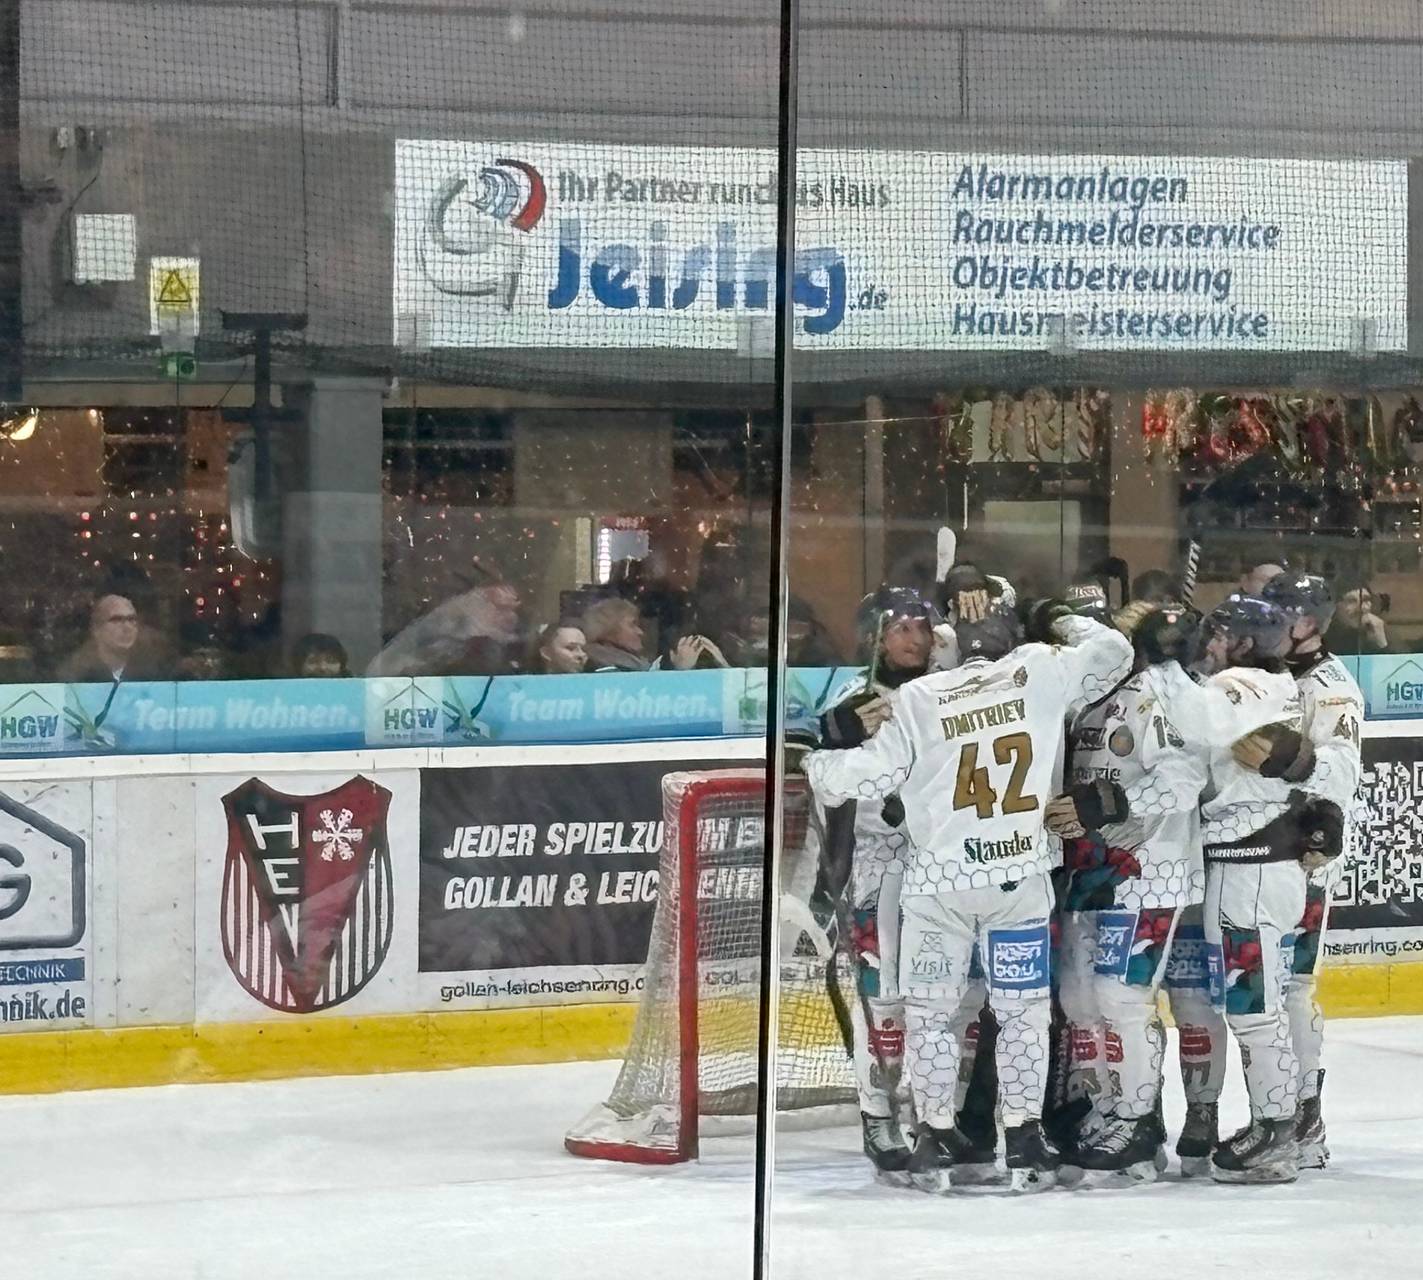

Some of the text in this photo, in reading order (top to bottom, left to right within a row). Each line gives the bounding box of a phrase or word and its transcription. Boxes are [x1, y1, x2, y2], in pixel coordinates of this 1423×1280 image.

[559, 168, 598, 202] Ihr
[606, 171, 701, 203] Partner
[951, 165, 1189, 210] Alarmanlagen
[952, 209, 1280, 248] Rauchmelderservice
[952, 256, 1233, 301] Objektbetreuung
[134, 698, 217, 731] Team
[384, 705, 440, 730] HGW
[509, 691, 584, 722] Team
[1, 715, 59, 739] HGW
[952, 731, 1039, 820] 42
[443, 824, 536, 859] JEDER
[544, 819, 665, 856] SPIELZU
[444, 873, 559, 910] GOLLAN
[563, 873, 590, 906] &
